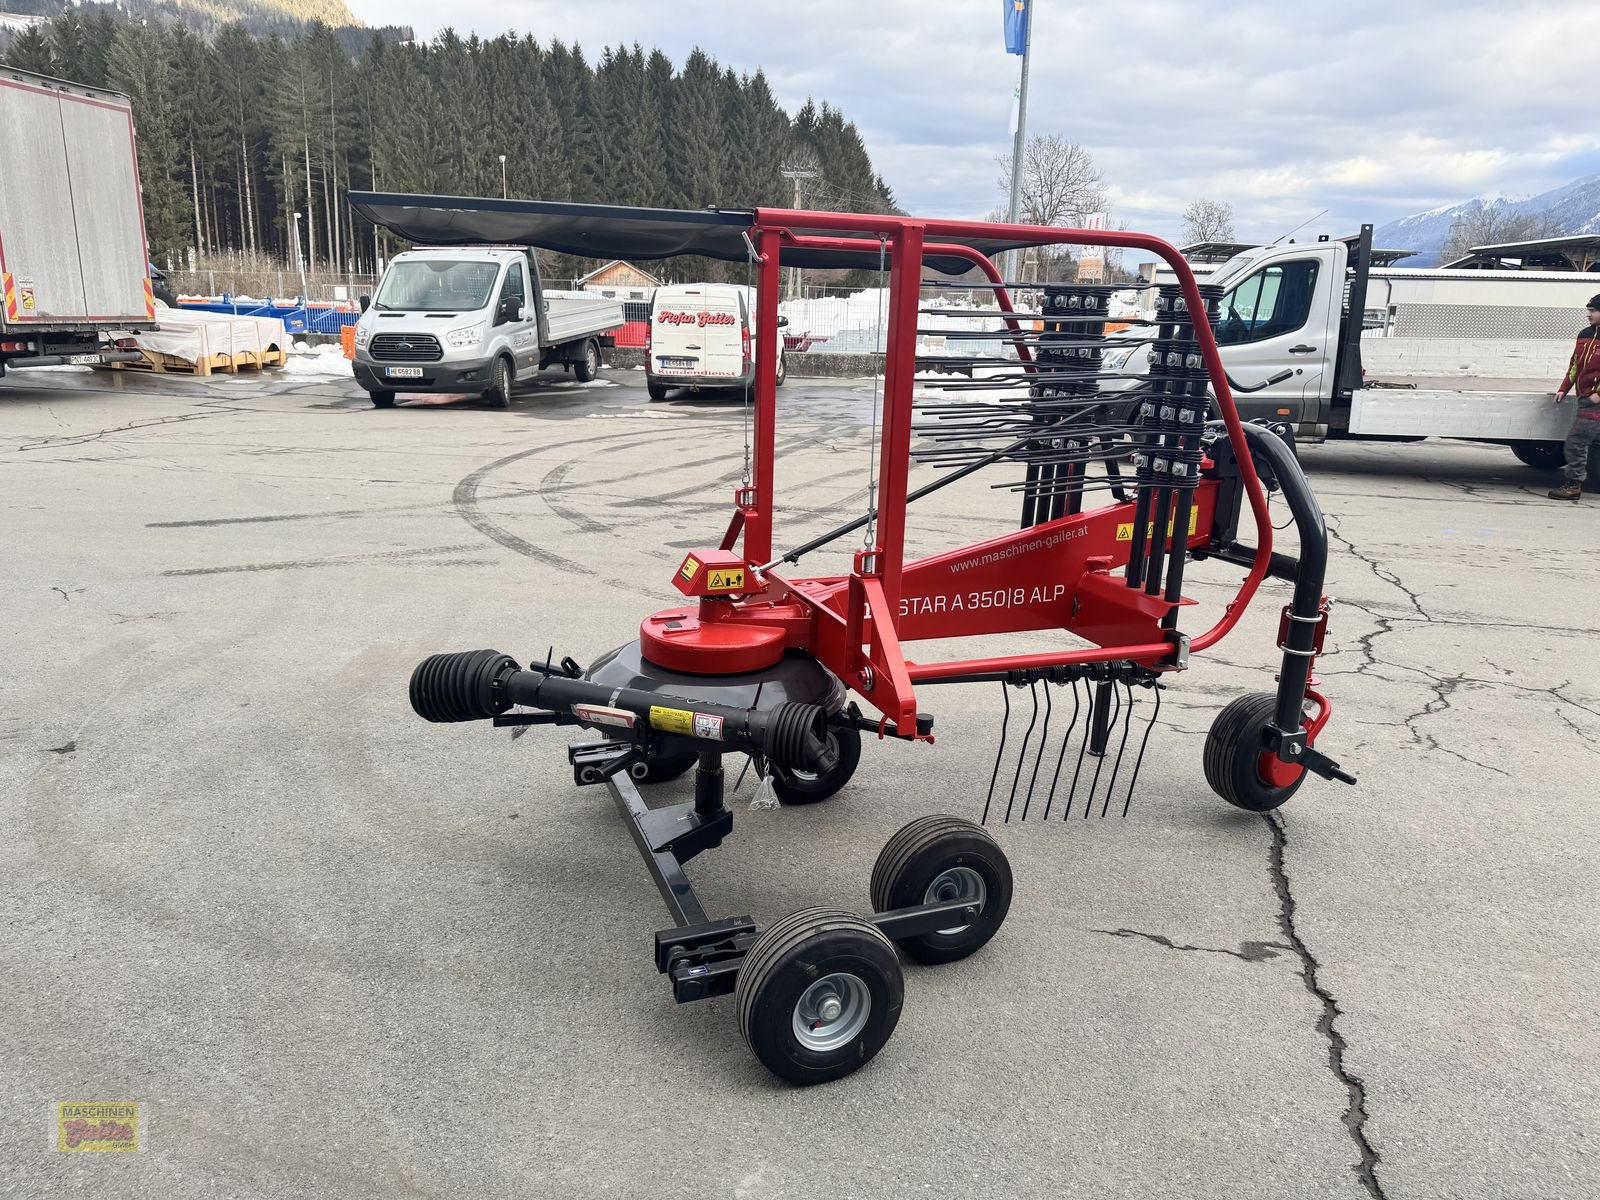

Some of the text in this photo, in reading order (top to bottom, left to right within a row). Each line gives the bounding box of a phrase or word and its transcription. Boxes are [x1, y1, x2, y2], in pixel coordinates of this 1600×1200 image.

[697, 311, 735, 327] Gailer
[950, 525, 1089, 574] www.maschinen-gailer.at
[951, 593, 964, 611] A
[1030, 584, 1065, 603] ALP
